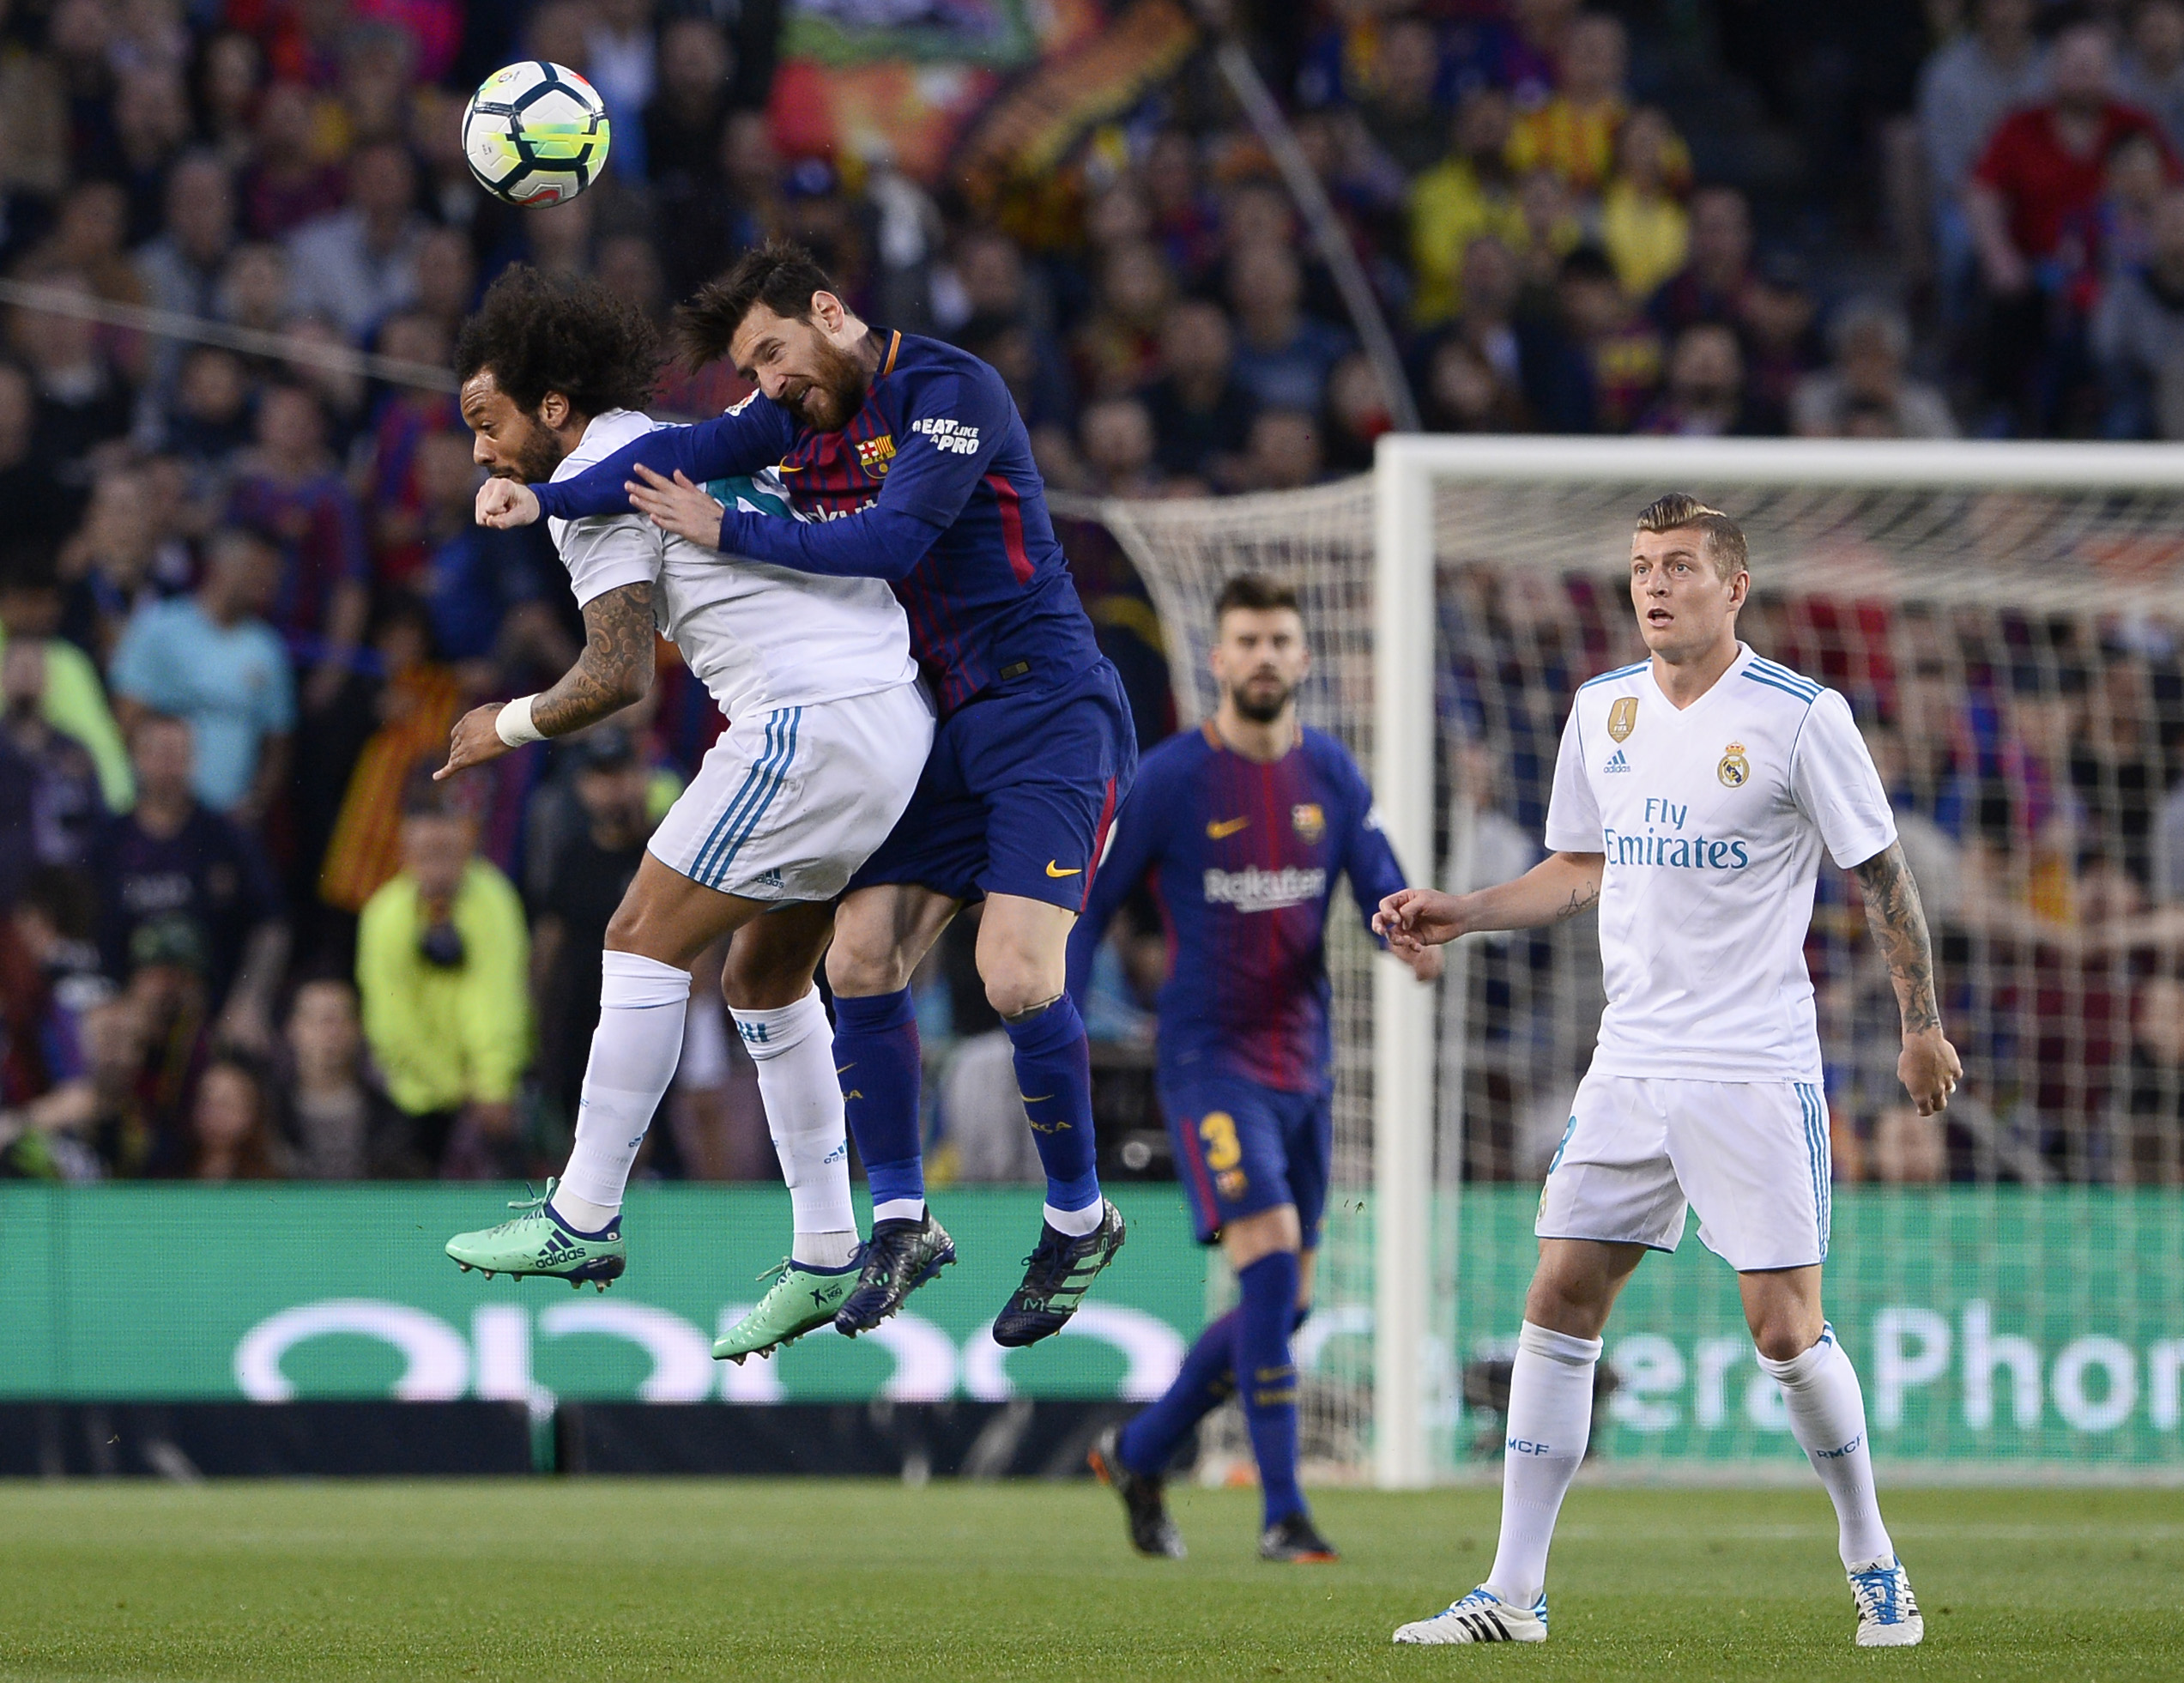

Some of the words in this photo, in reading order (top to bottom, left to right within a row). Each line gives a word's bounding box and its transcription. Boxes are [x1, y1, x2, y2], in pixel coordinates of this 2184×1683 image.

[937, 435, 979, 455] PRO
[1603, 762, 1631, 773] adidas
[1645, 798, 1687, 830] Fly
[1604, 827, 1748, 869] Emirates
[1203, 865, 1327, 906] Rakuten
[1199, 1111, 1242, 1171] 3
[535, 1247, 586, 1268] adidas
[1508, 1438, 1549, 1456] MCF
